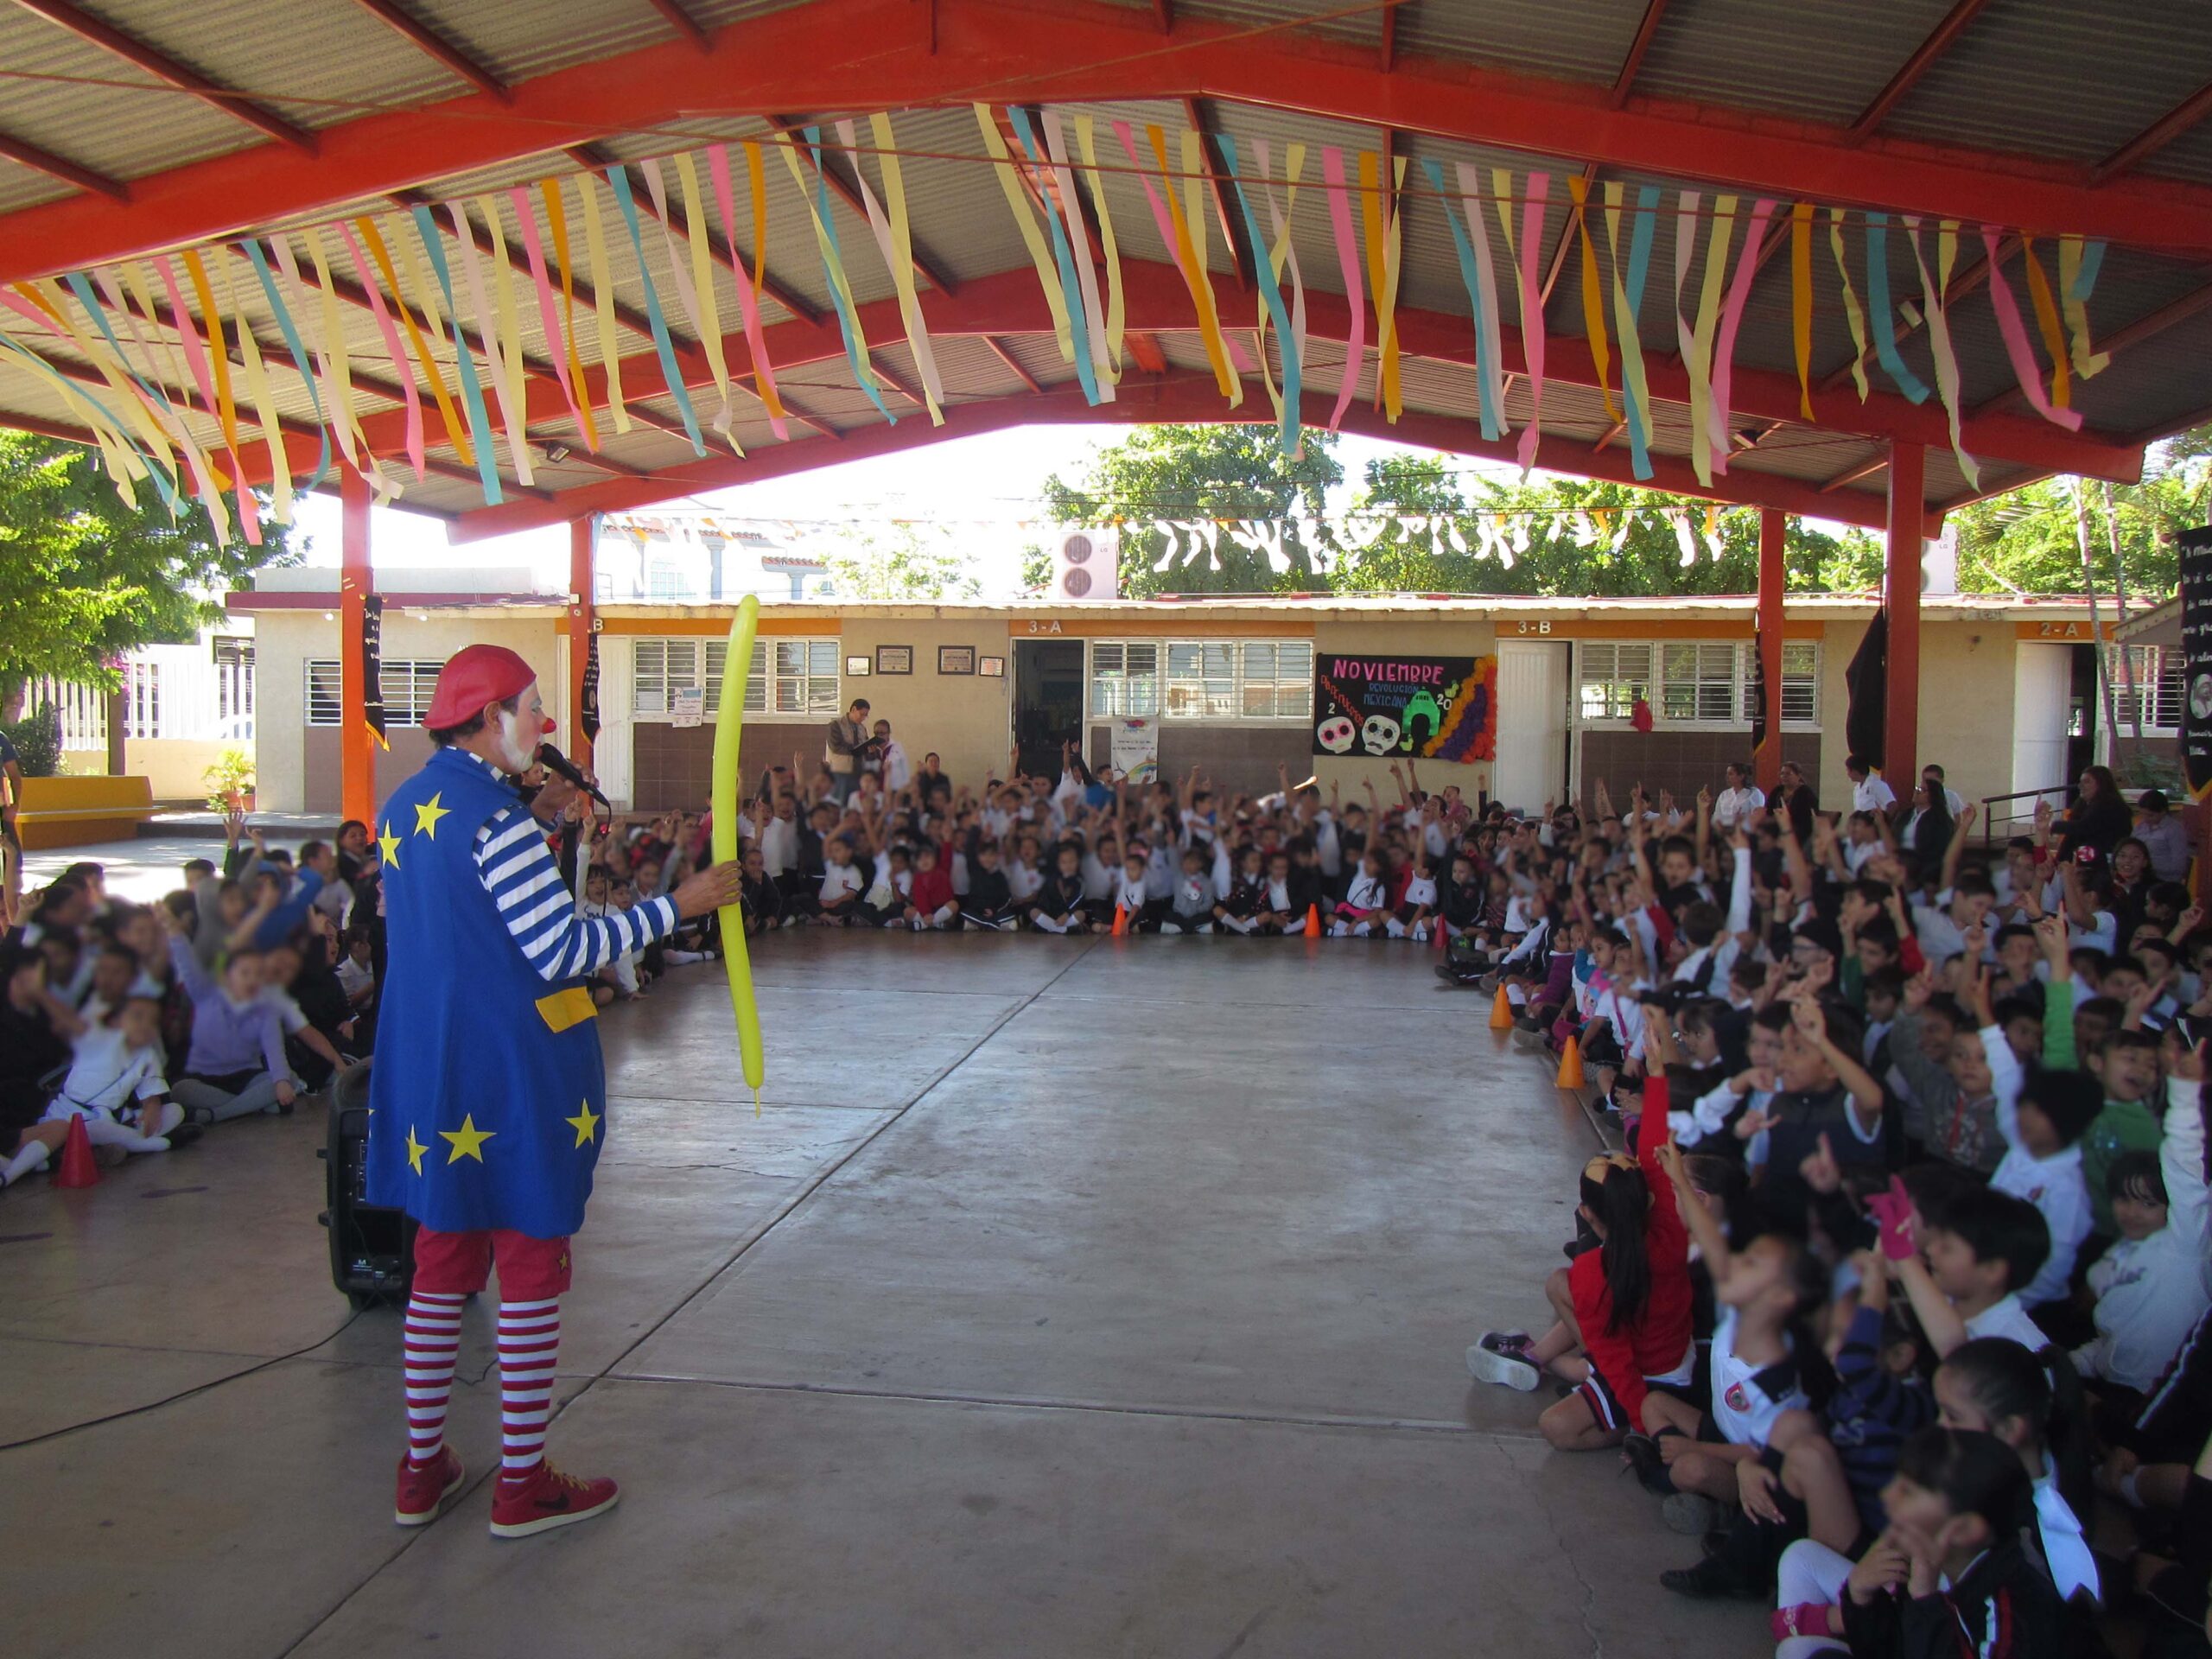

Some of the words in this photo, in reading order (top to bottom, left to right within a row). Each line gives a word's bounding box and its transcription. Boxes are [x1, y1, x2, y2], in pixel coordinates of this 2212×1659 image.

[1333, 659, 1444, 684] NOVIEMBRE
[1328, 702, 1335, 715] 2
[1363, 693, 1408, 709] MEXICANA
[1437, 694, 1452, 710] 20
